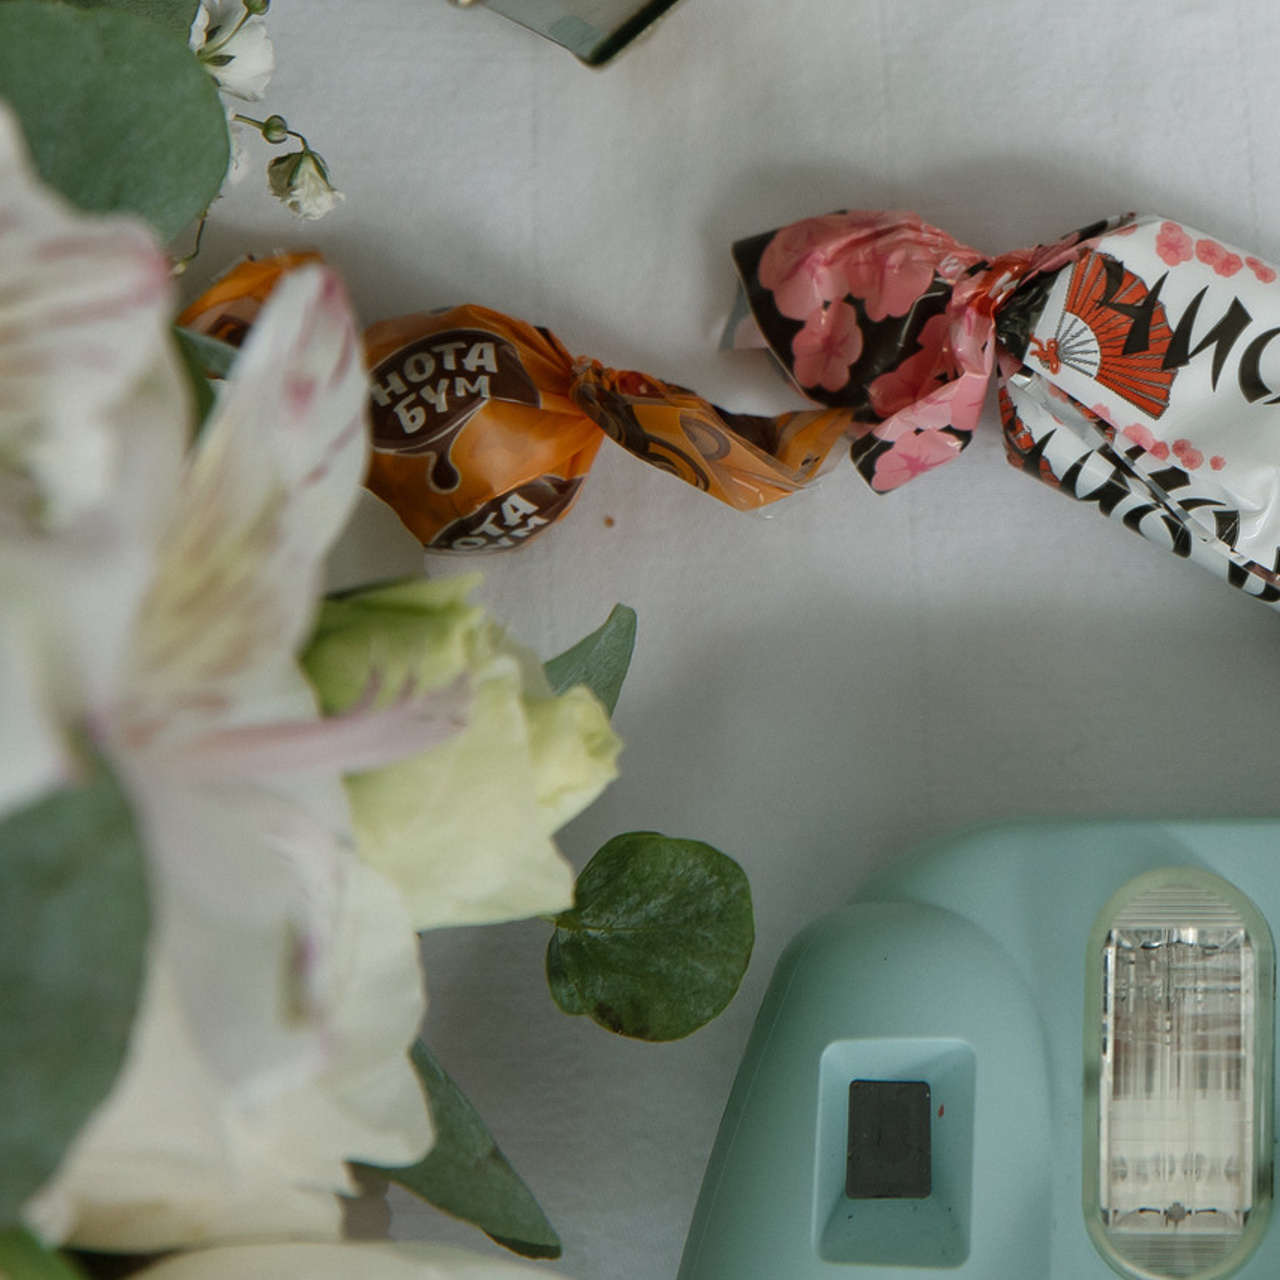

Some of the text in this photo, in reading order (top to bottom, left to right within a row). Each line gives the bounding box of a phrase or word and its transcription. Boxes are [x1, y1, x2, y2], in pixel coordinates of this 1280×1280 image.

[371, 341, 499, 407] НОТА
[393, 374, 491, 435] БУМ
[450, 493, 540, 551] ОТА
